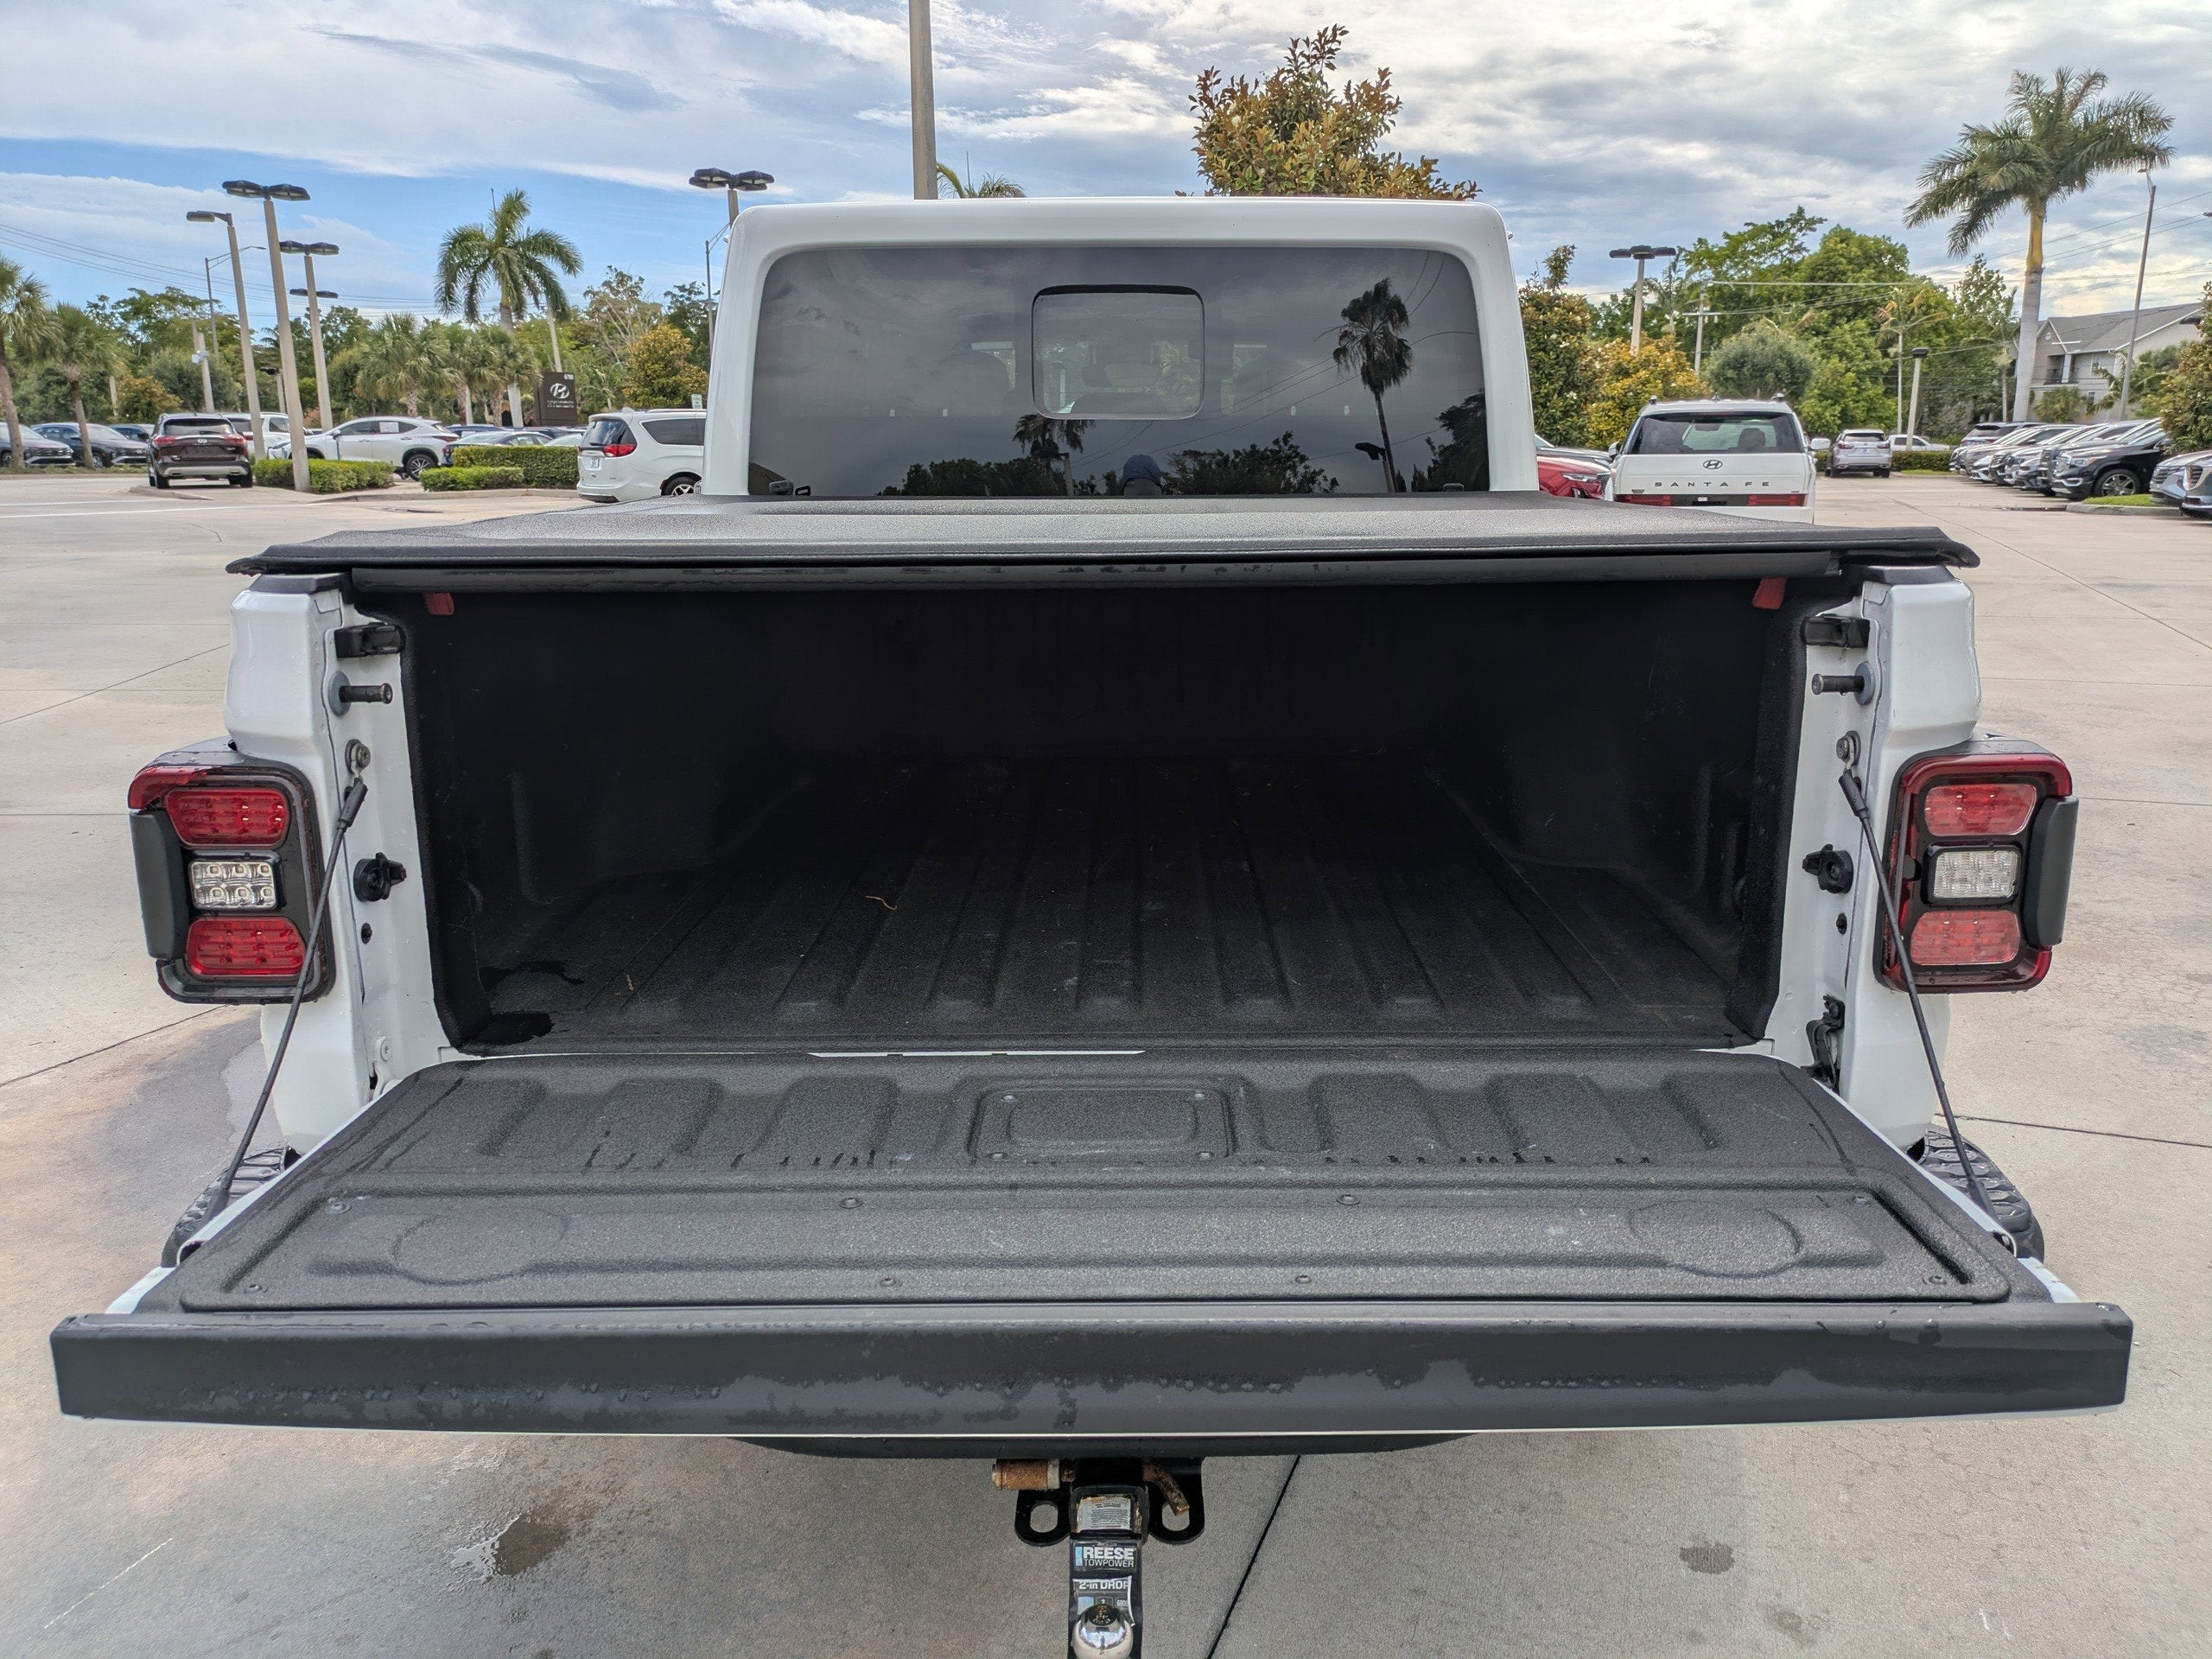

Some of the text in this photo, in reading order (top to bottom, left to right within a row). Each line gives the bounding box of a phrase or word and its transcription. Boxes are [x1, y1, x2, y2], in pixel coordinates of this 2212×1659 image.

[1084, 1547, 1135, 1560] REESE
[1084, 1558, 1135, 1568] TOWPOWER
[1078, 1581, 1098, 1590] 2-in
